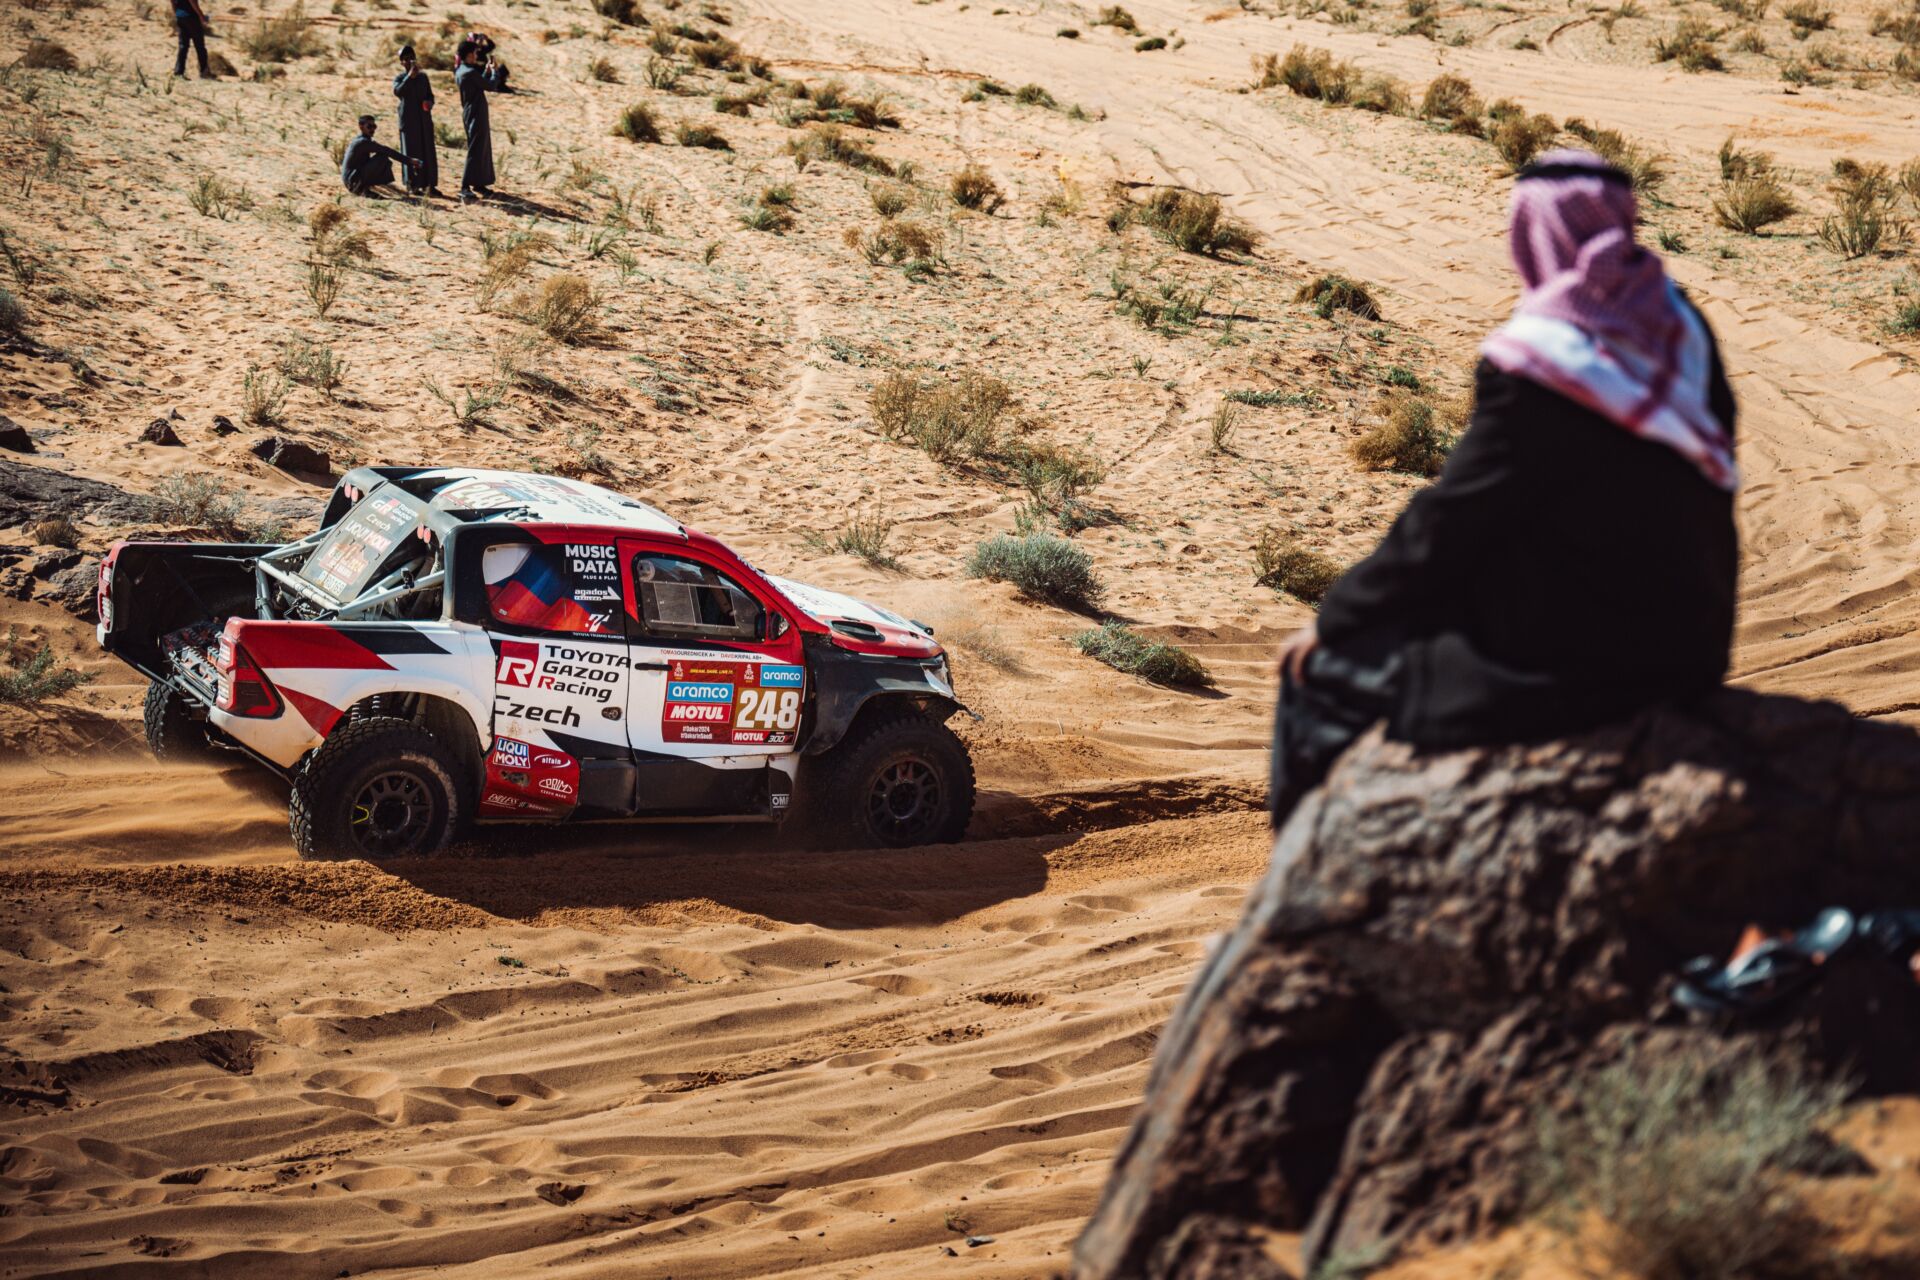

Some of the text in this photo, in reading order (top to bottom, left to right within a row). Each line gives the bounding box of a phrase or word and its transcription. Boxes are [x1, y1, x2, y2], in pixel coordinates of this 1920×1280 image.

[366, 513, 391, 532] Czech
[345, 520, 392, 552] LIQUI MOLY
[565, 544, 616, 559] MUSIC
[573, 560, 617, 574] DATA
[574, 588, 608, 596] agados
[545, 644, 631, 668] TOYOTA
[542, 660, 620, 684] GAZOO
[763, 672, 801, 681] aramco
[537, 675, 613, 703] Racing
[672, 686, 729, 699] aramco
[670, 705, 724, 720] MOTUL
[736, 689, 800, 729] 248
[734, 732, 764, 741] MOTUL
[497, 738, 527, 757] LIQUI
[495, 752, 528, 767] MOLY
[545, 778, 568, 793] PRIM
